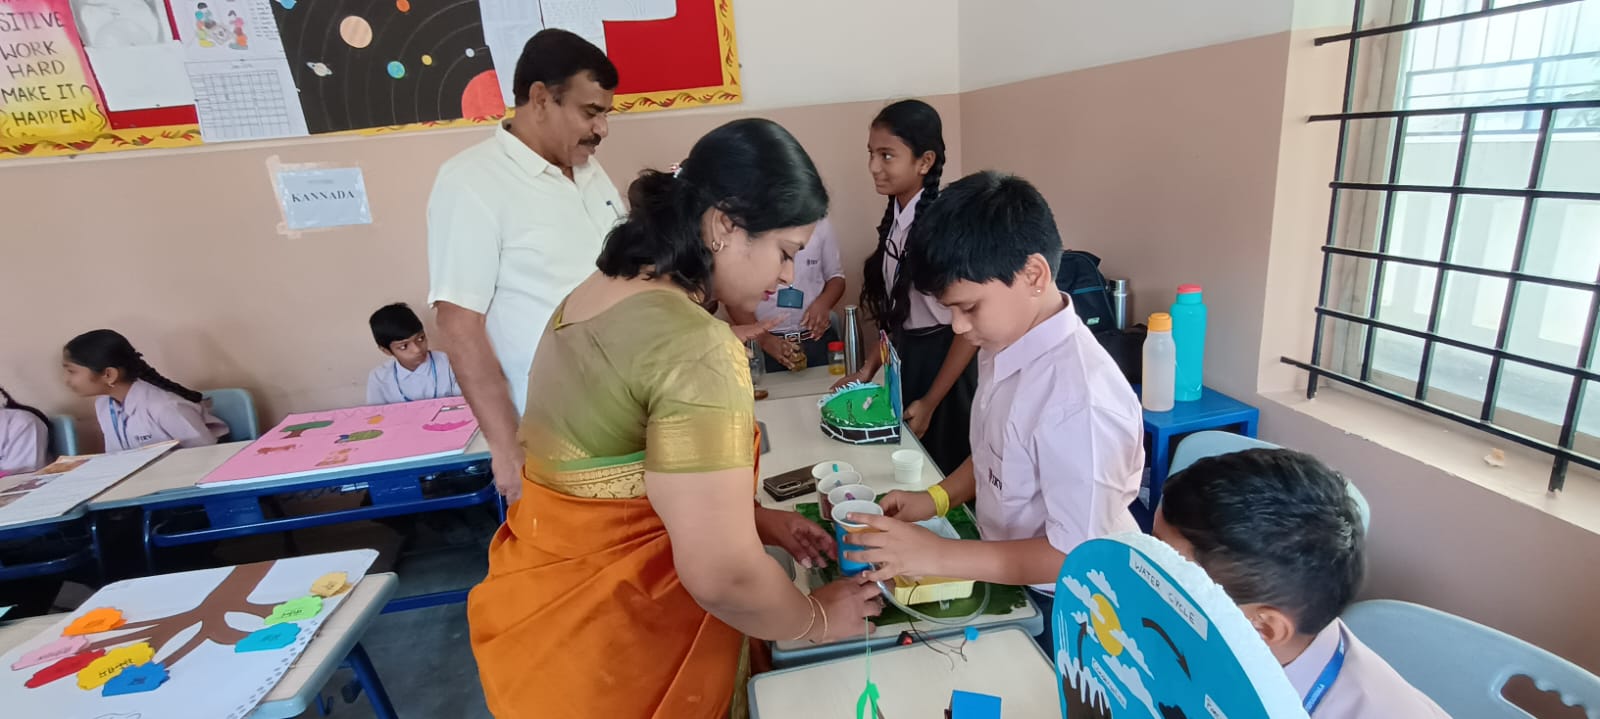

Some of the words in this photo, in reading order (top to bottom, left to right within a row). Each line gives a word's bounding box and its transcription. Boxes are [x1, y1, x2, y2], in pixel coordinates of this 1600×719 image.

[0, 41, 57, 60] WORK
[6, 60, 65, 79] HARD
[1, 85, 51, 104] MAKE
[57, 83, 76, 99] IT
[12, 107, 86, 127] HAPPEN
[291, 190, 355, 203] KANNADA
[1134, 560, 1161, 589] WATER
[1167, 592, 1195, 625] CYCLE
